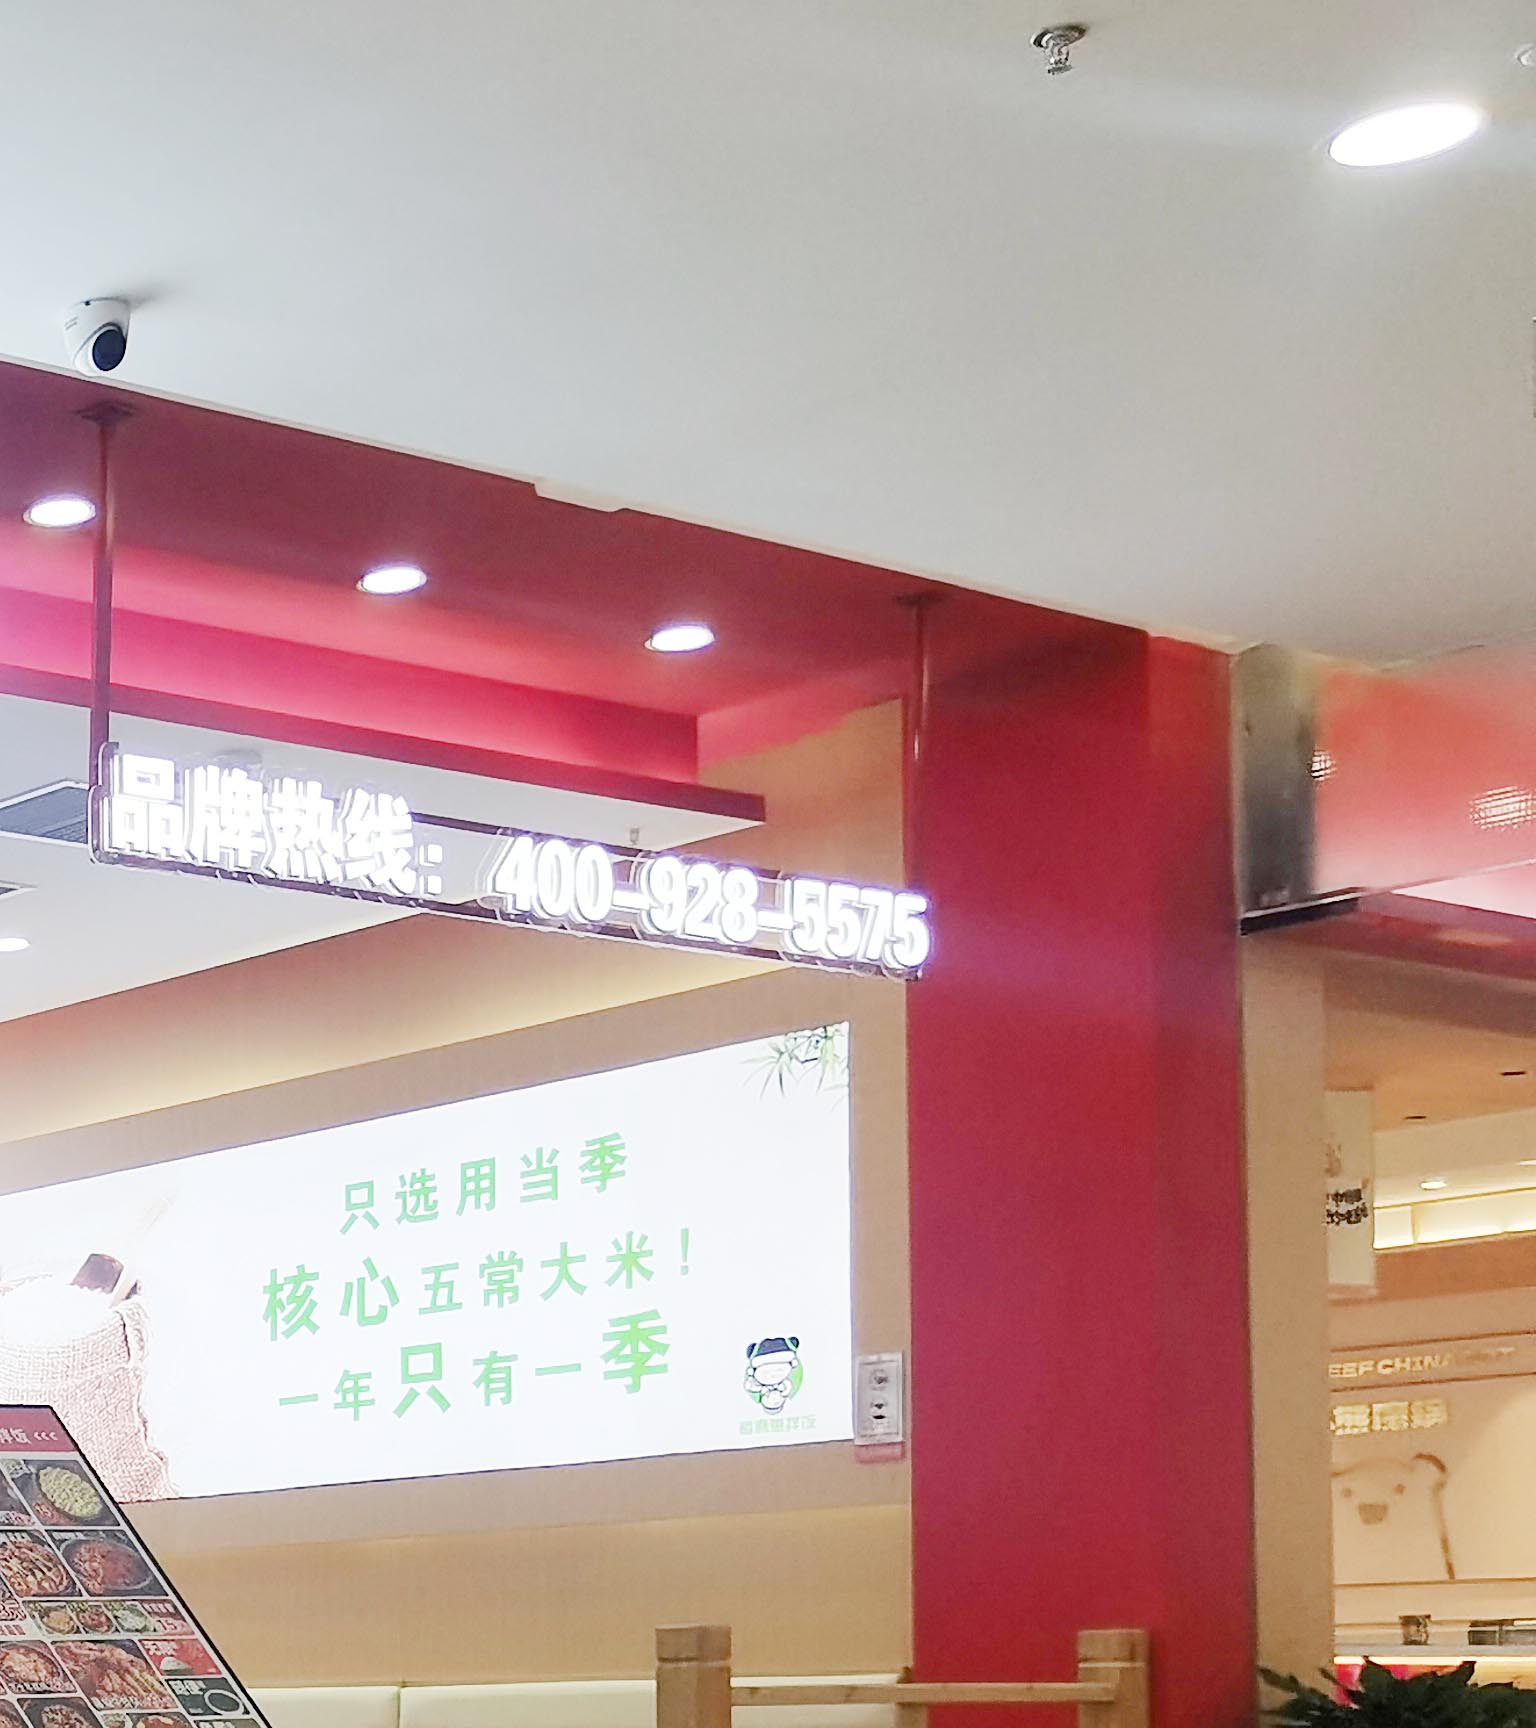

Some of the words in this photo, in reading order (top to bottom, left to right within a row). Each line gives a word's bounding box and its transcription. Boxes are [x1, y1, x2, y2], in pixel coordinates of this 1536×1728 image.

[490, 832, 932, 972] 400-928-5575
[338, 1131, 629, 1237] 只选用当季
[277, 1308, 672, 1423] 一年只有一季
